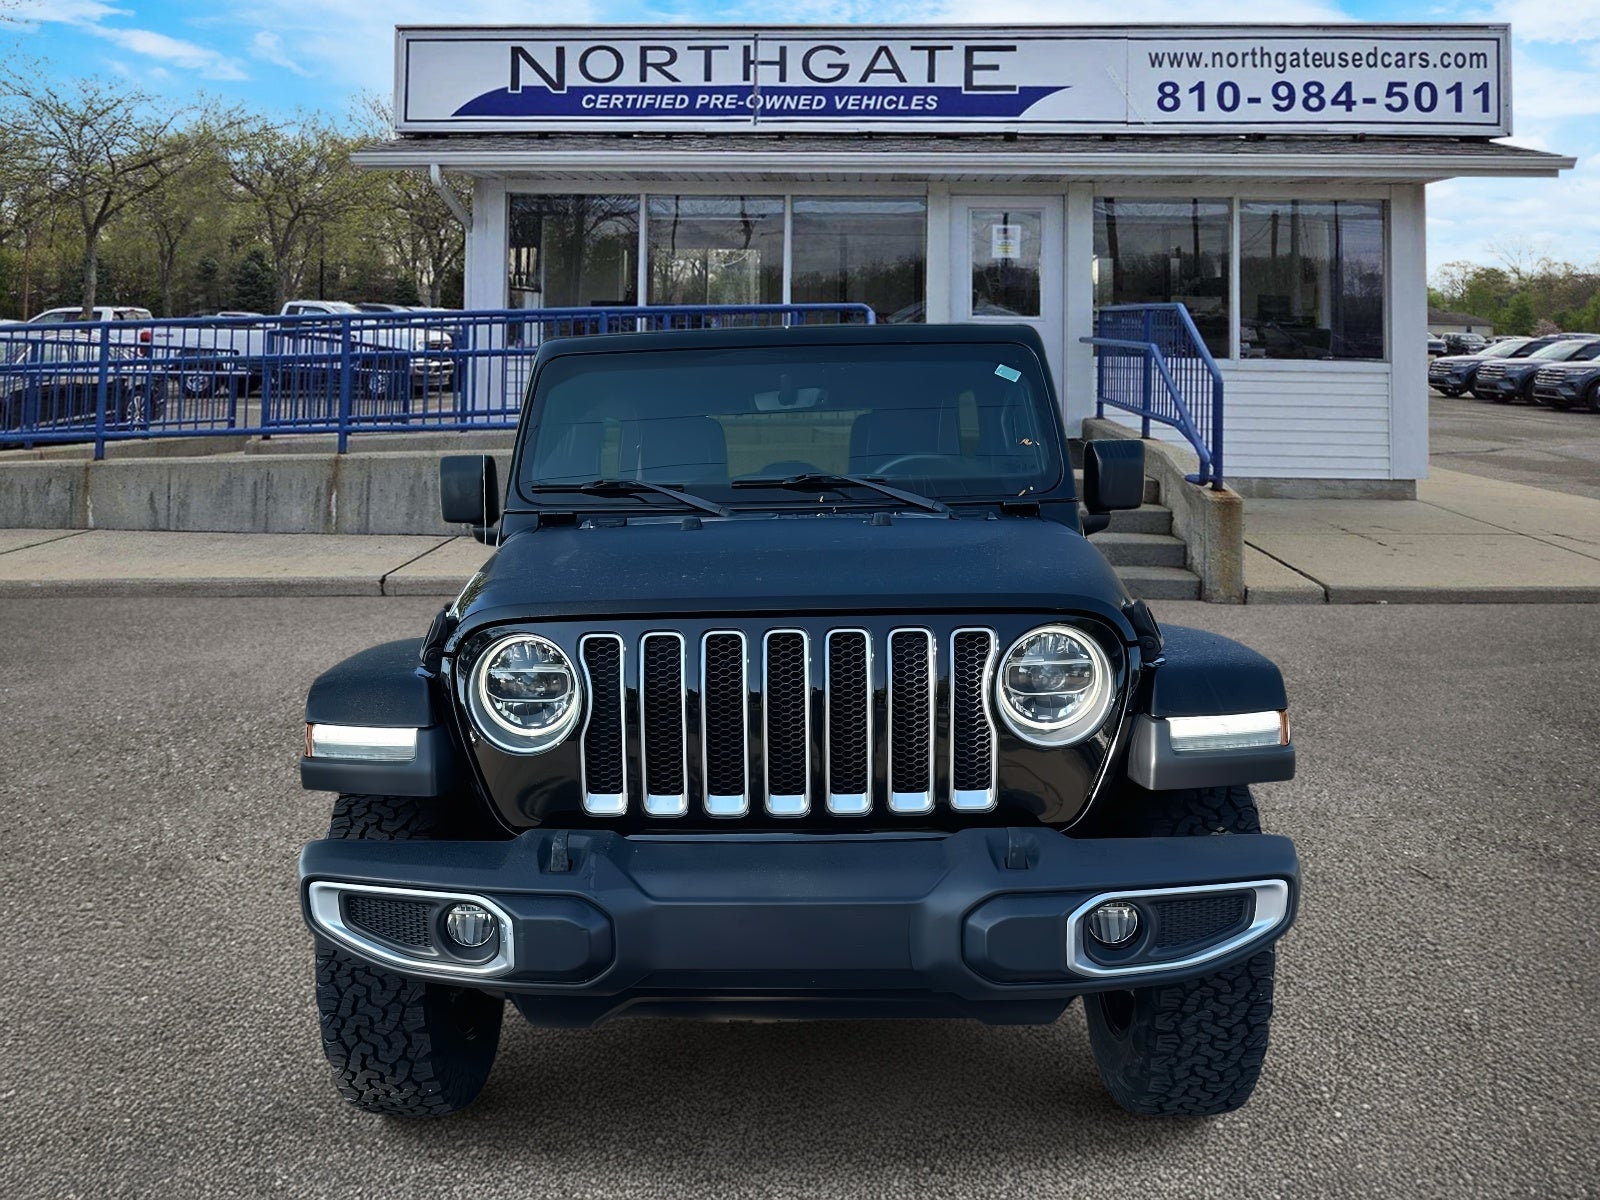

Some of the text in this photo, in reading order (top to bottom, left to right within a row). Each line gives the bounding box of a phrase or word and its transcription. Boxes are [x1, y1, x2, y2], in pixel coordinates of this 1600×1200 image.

[510, 45, 1017, 92] NORTHGATE
[1148, 46, 1488, 74] www.northgateusedcars.com
[581, 94, 939, 111] CERTIFIED PRE-OWNED VEHICLES
[1156, 80, 1491, 114] 810-984-5011
